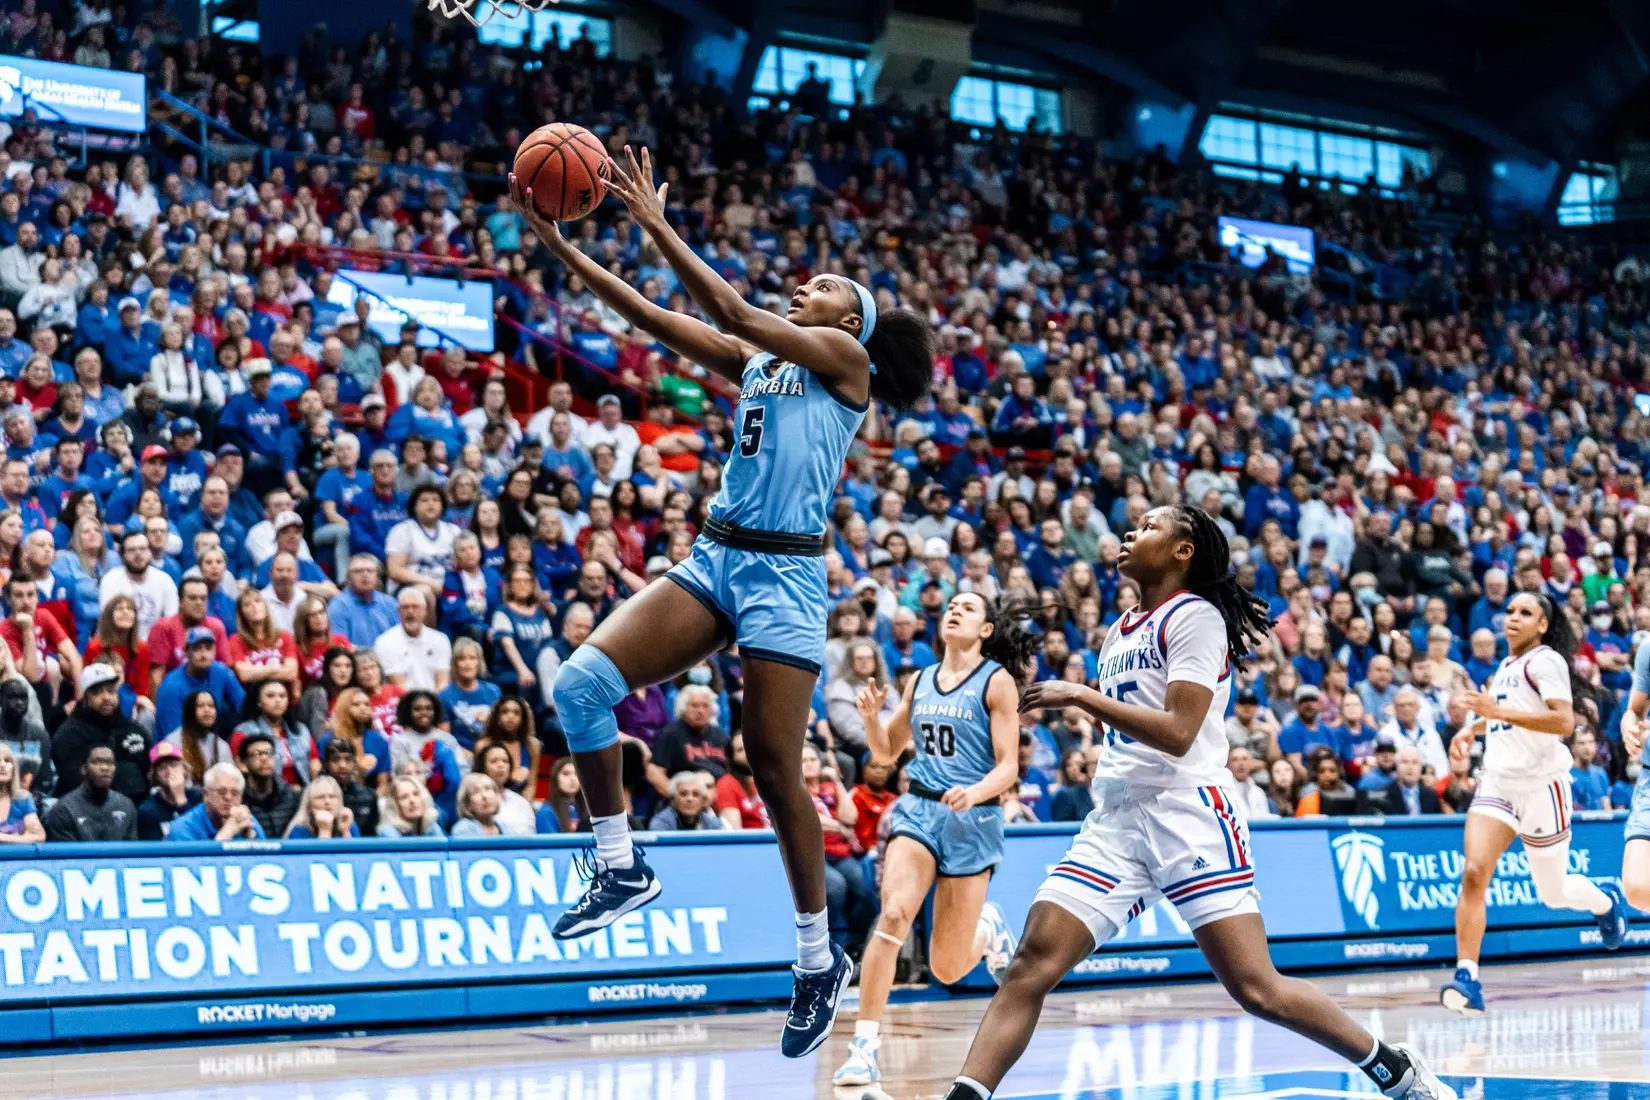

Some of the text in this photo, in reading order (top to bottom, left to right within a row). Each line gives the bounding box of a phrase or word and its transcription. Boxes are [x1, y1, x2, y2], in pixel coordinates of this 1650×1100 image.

[740, 405, 766, 459] 5
[920, 721, 957, 758] 20
[1390, 850, 1438, 880] THE
[1397, 877, 1544, 911] KANS HEALT
[587, 983, 708, 1003] ROCKET Mortgage
[197, 1003, 336, 1024] ROCKET Mortgage
